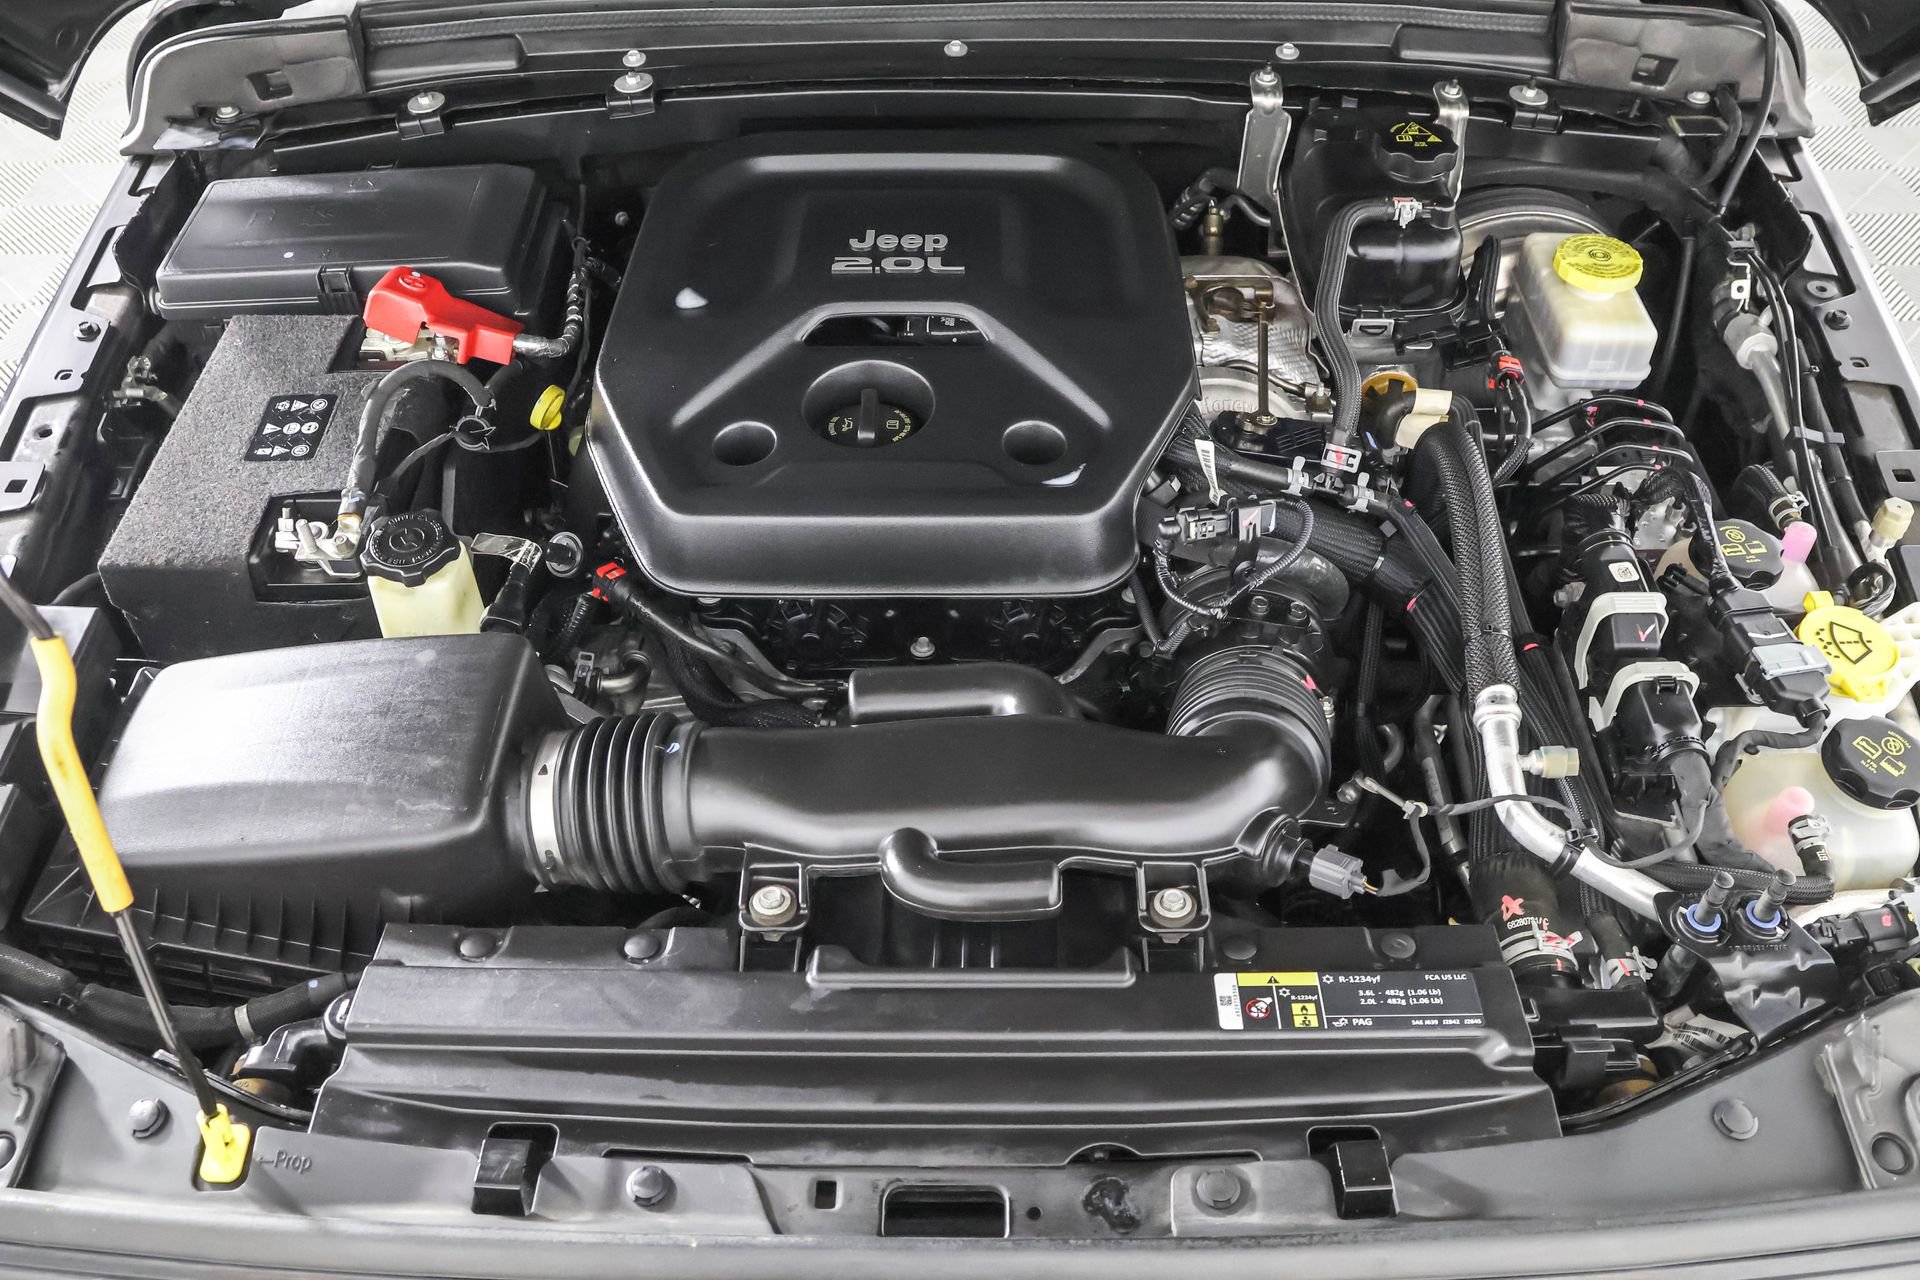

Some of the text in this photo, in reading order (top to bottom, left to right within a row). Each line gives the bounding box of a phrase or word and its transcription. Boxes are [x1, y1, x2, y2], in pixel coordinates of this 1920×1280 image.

[849, 229, 949, 252] Jeep
[831, 256, 966, 274] 2.0L
[1338, 975, 1381, 985] R-1234yf
[1358, 989, 1376, 997] 3.6L
[1385, 989, 1405, 997] 482g
[1407, 988, 1428, 997] (1.06
[1428, 988, 1442, 997] Lb)
[1387, 998, 1407, 1006] 482g
[1409, 997, 1430, 1006] (1.06
[1430, 997, 1444, 1005] Lb)
[1352, 1018, 1373, 1026] PAG
[273, 1149, 312, 1175] Prop
